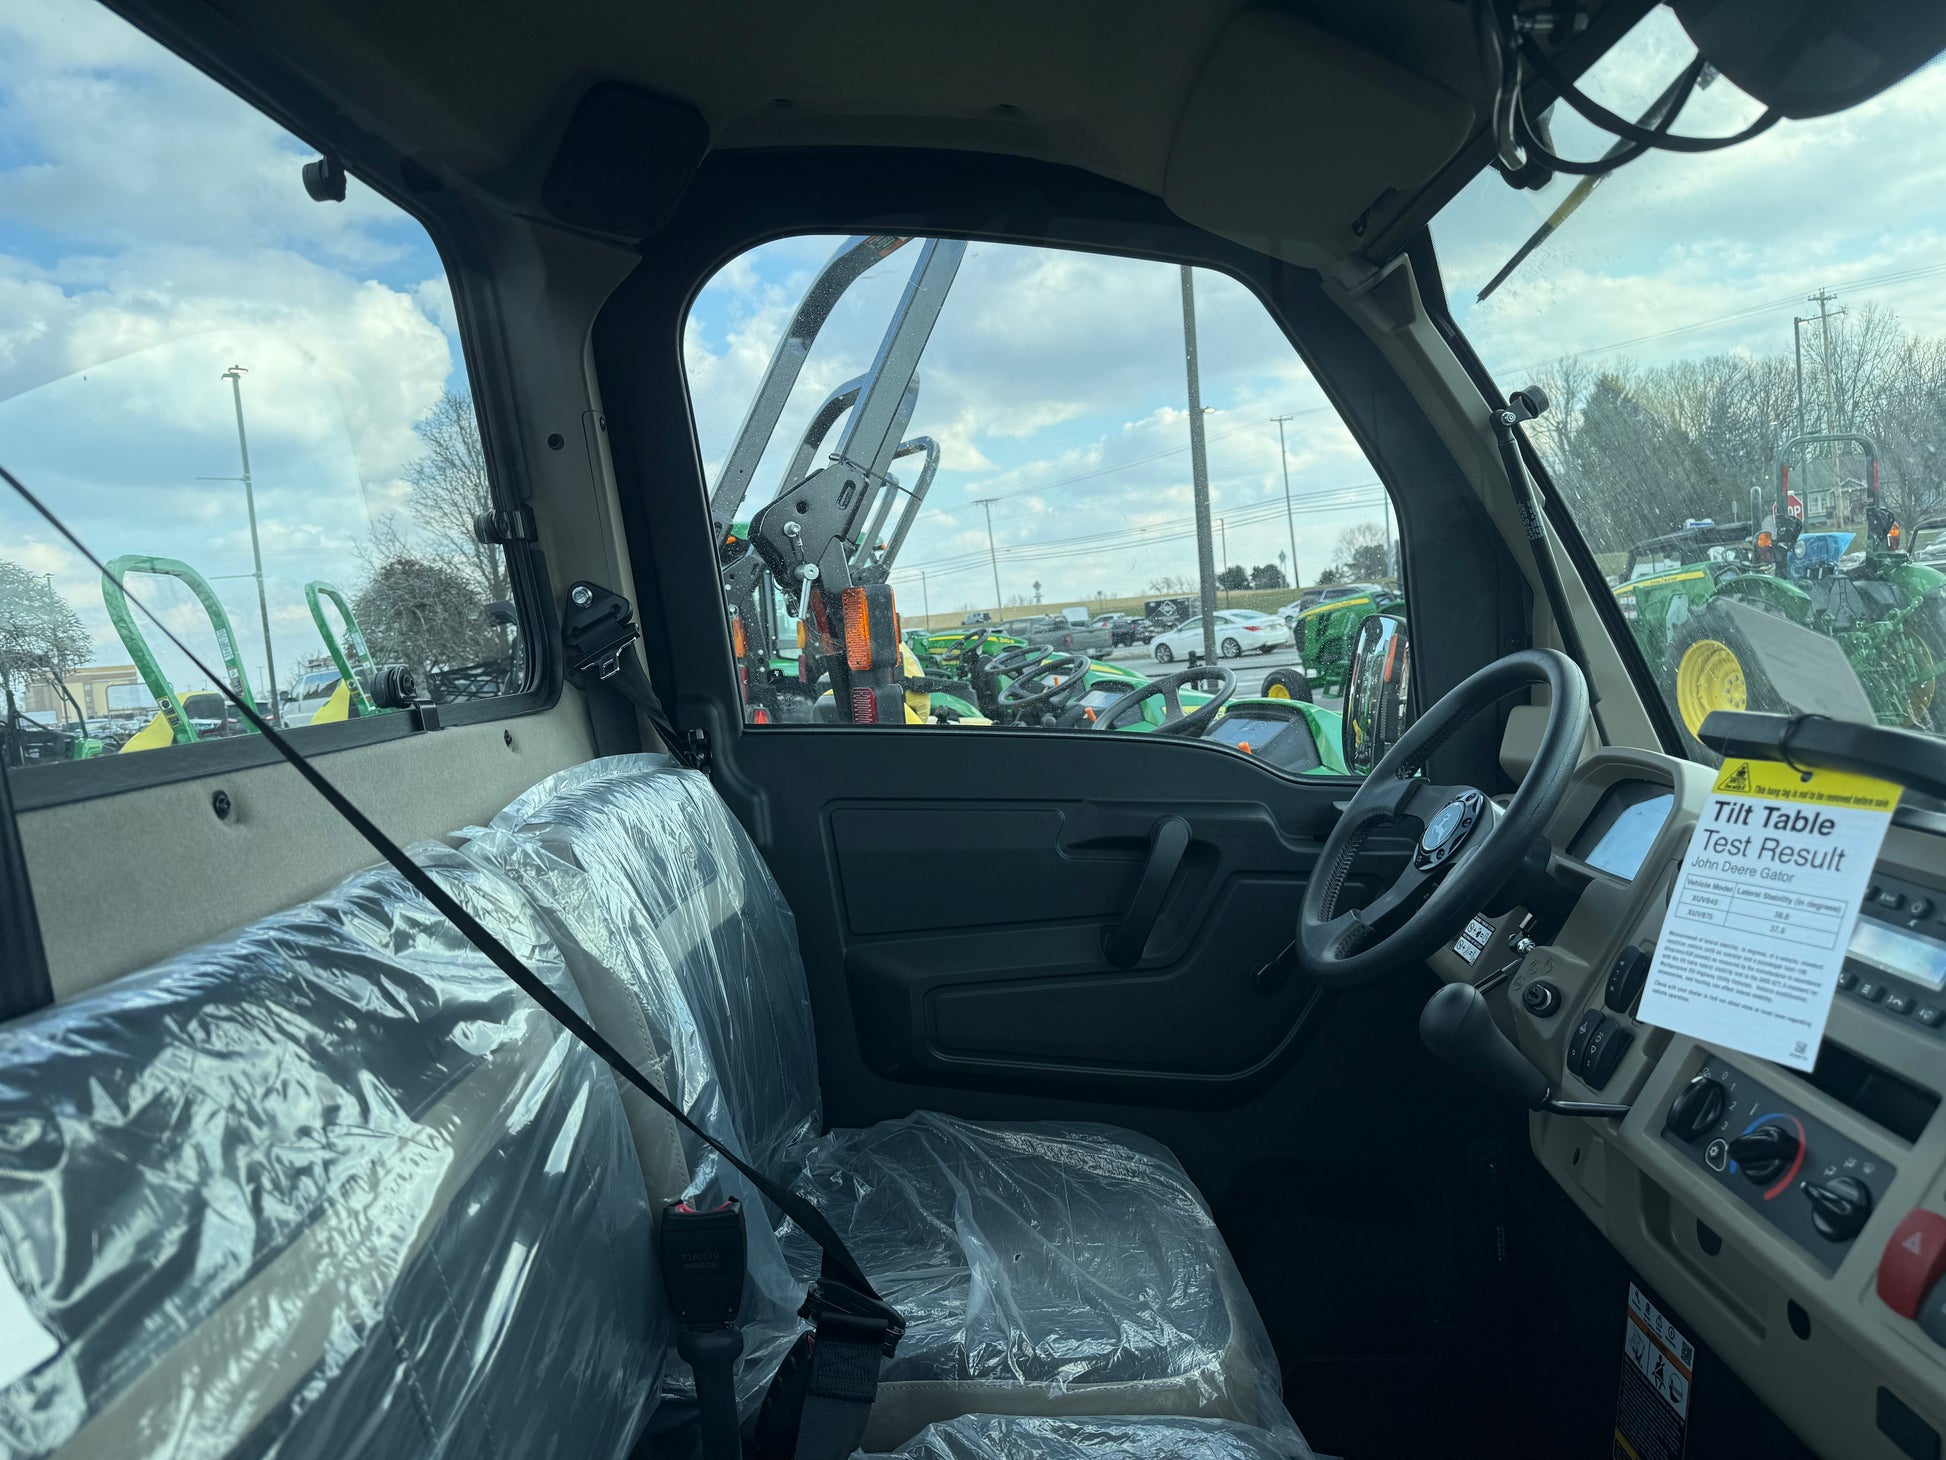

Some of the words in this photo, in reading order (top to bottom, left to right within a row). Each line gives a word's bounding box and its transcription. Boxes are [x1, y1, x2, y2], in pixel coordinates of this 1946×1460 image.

[1755, 785, 1766, 795] This
[1767, 787, 1781, 798] hang
[1781, 789, 1791, 799] tag
[1713, 800, 1753, 826] Tilt
[1762, 806, 1836, 837] Table
[1704, 828, 1753, 858] Test
[1757, 837, 1846, 872] Result
[1691, 856, 1719, 871] John
[1721, 861, 1757, 877] Deere
[1760, 866, 1795, 883] Gator
[1686, 878, 1712, 890] Vehicle
[1712, 882, 1734, 893] Model
[1737, 888, 1761, 899] Lateral
[1762, 892, 1794, 905] Stability
[1794, 897, 1805, 908] (in
[1806, 900, 1843, 915] degrees)
[1721, 1071, 1729, 1081] 0
[1728, 1101, 1737, 1111] 2
[1720, 1120, 1729, 1131] 3
